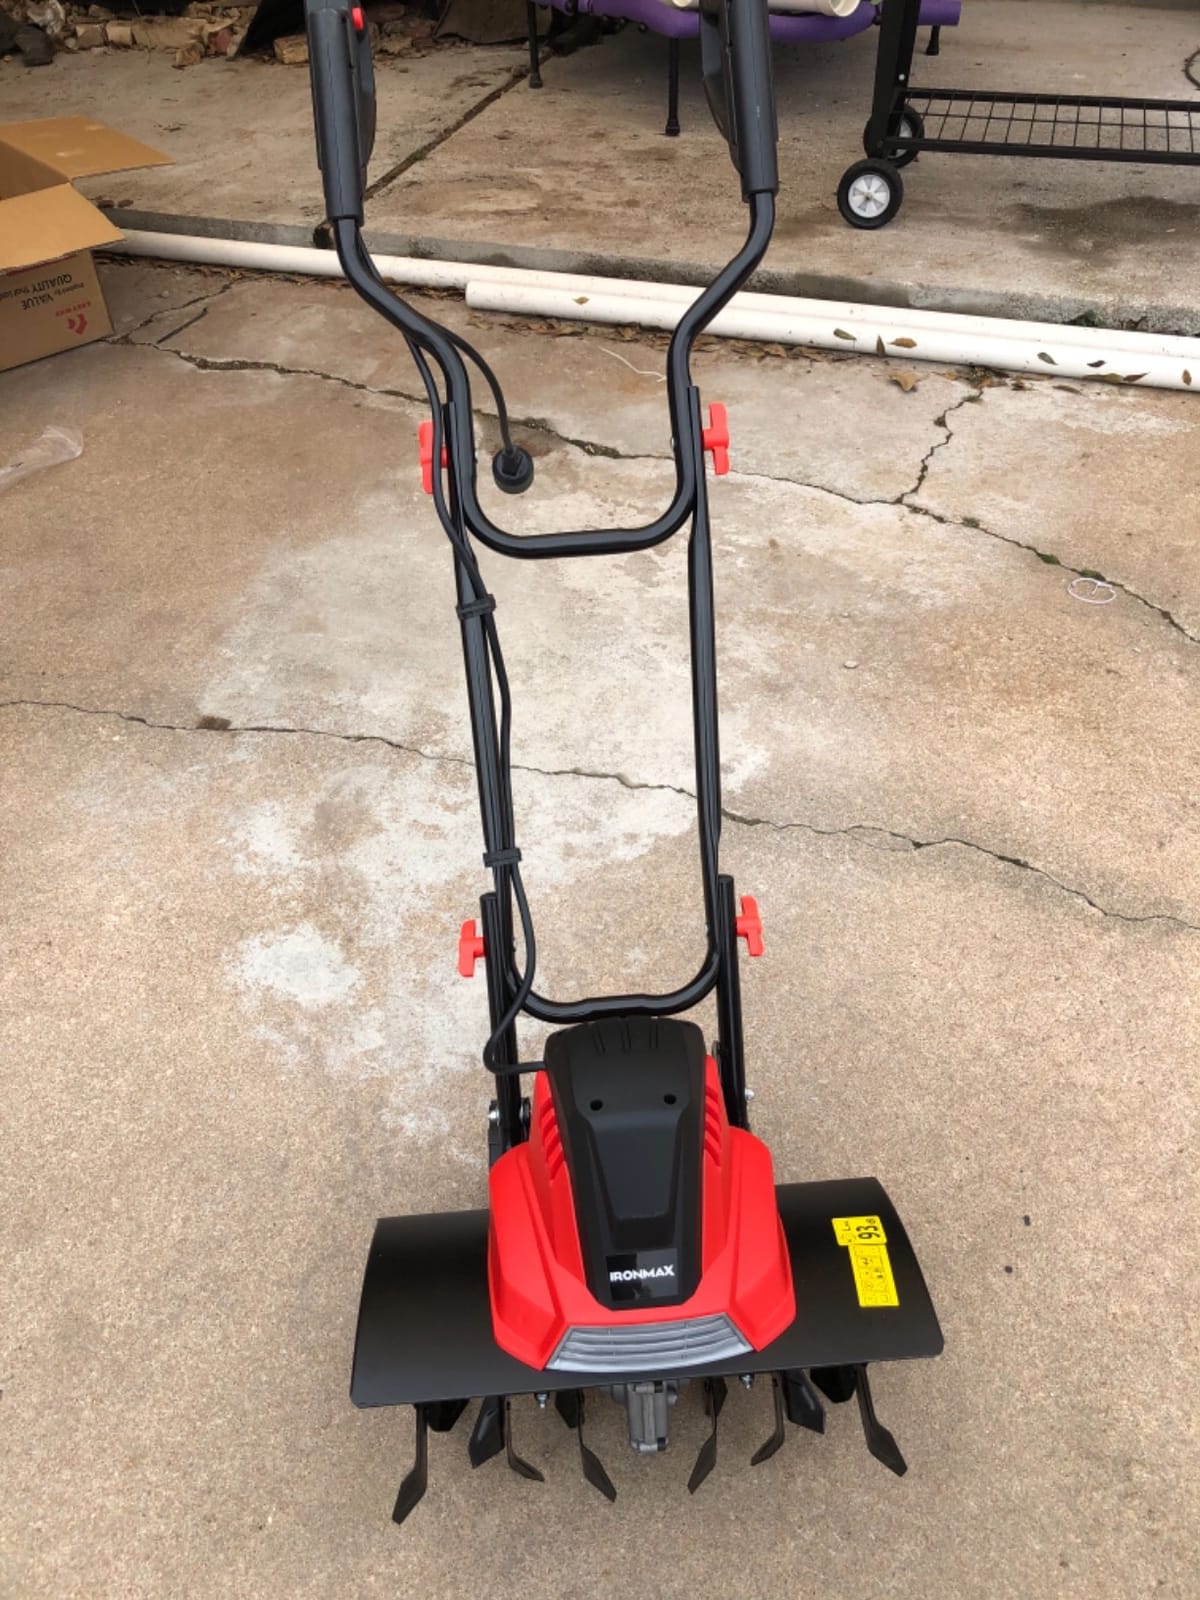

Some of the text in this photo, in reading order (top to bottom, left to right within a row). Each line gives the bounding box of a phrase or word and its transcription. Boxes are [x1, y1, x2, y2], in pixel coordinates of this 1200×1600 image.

[32, 274, 72, 291] QUALITY
[21, 294, 54, 311] VALUE
[856, 1225, 881, 1240] 93
[609, 1264, 675, 1282] IRONMAX
